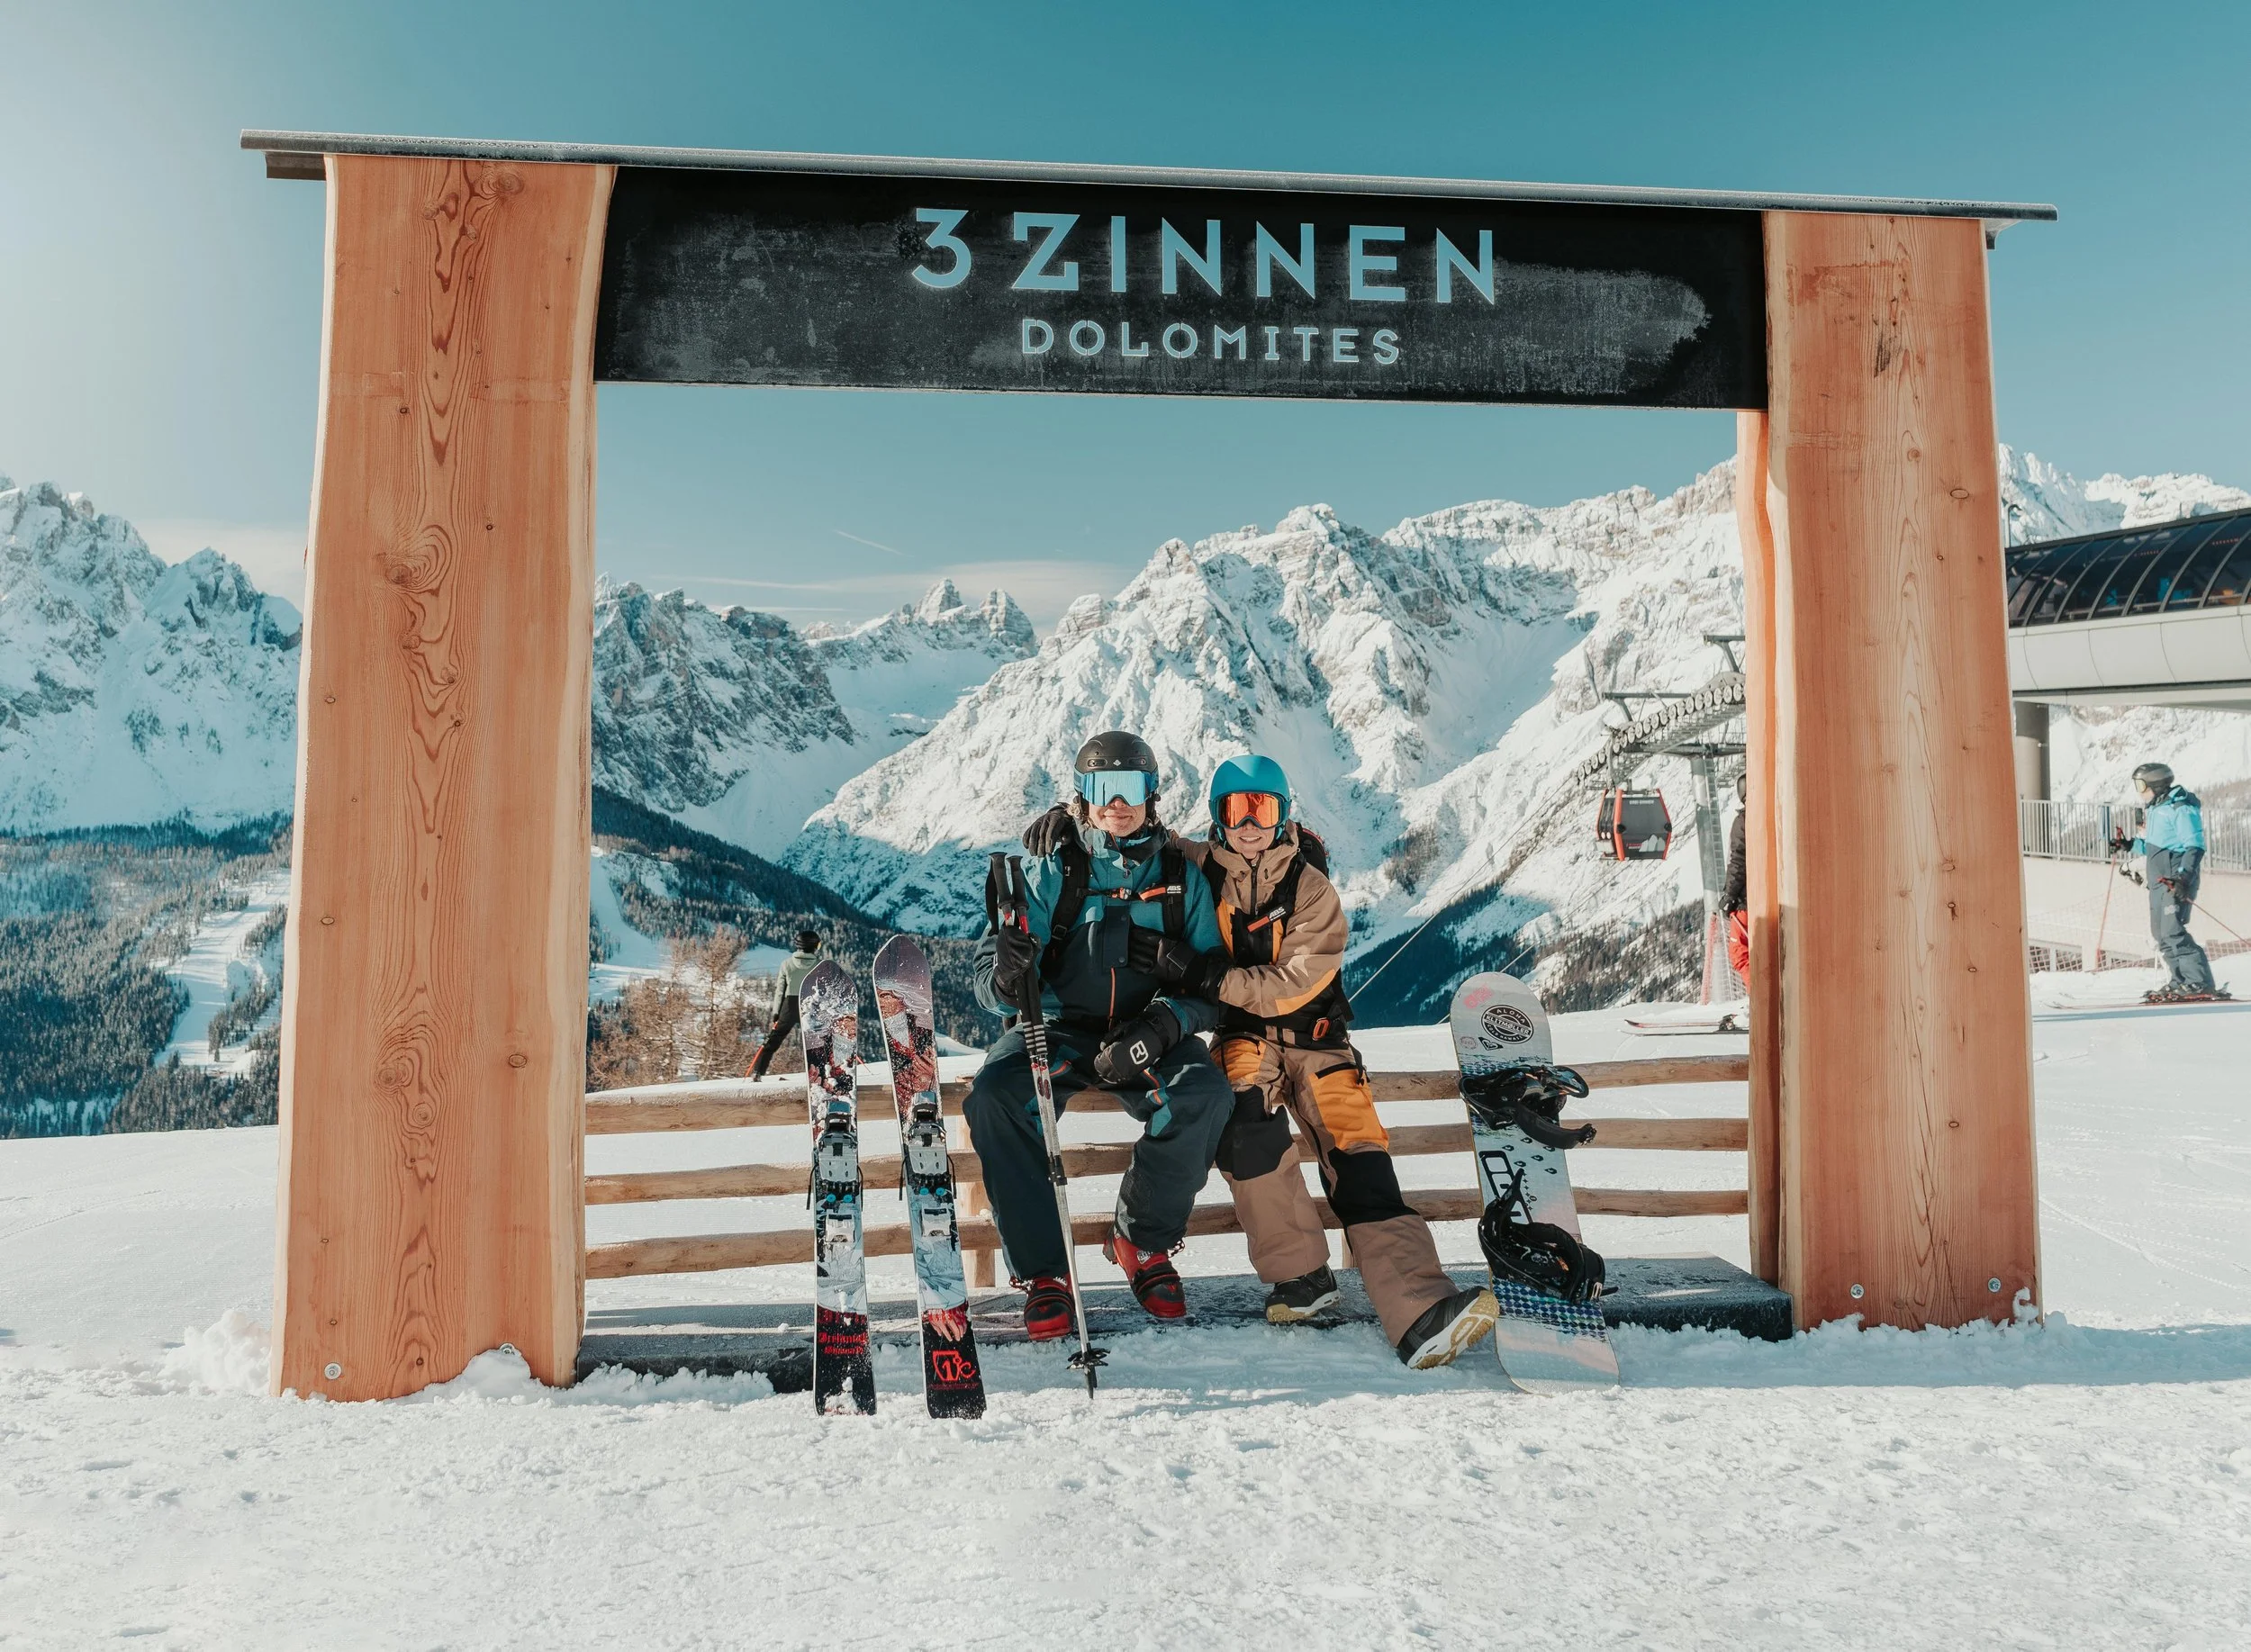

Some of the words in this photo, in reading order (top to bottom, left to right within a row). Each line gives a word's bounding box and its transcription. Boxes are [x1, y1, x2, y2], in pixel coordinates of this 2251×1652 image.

[912, 208, 972, 289] 3
[1012, 212, 1495, 305] ZINNEN
[1021, 319, 1400, 365] DOLOMITES
[1270, 907, 1285, 919] ABS
[1486, 1015, 1531, 1035] KLITMØLLER
[1496, 1008, 1526, 1024] ALOHA
